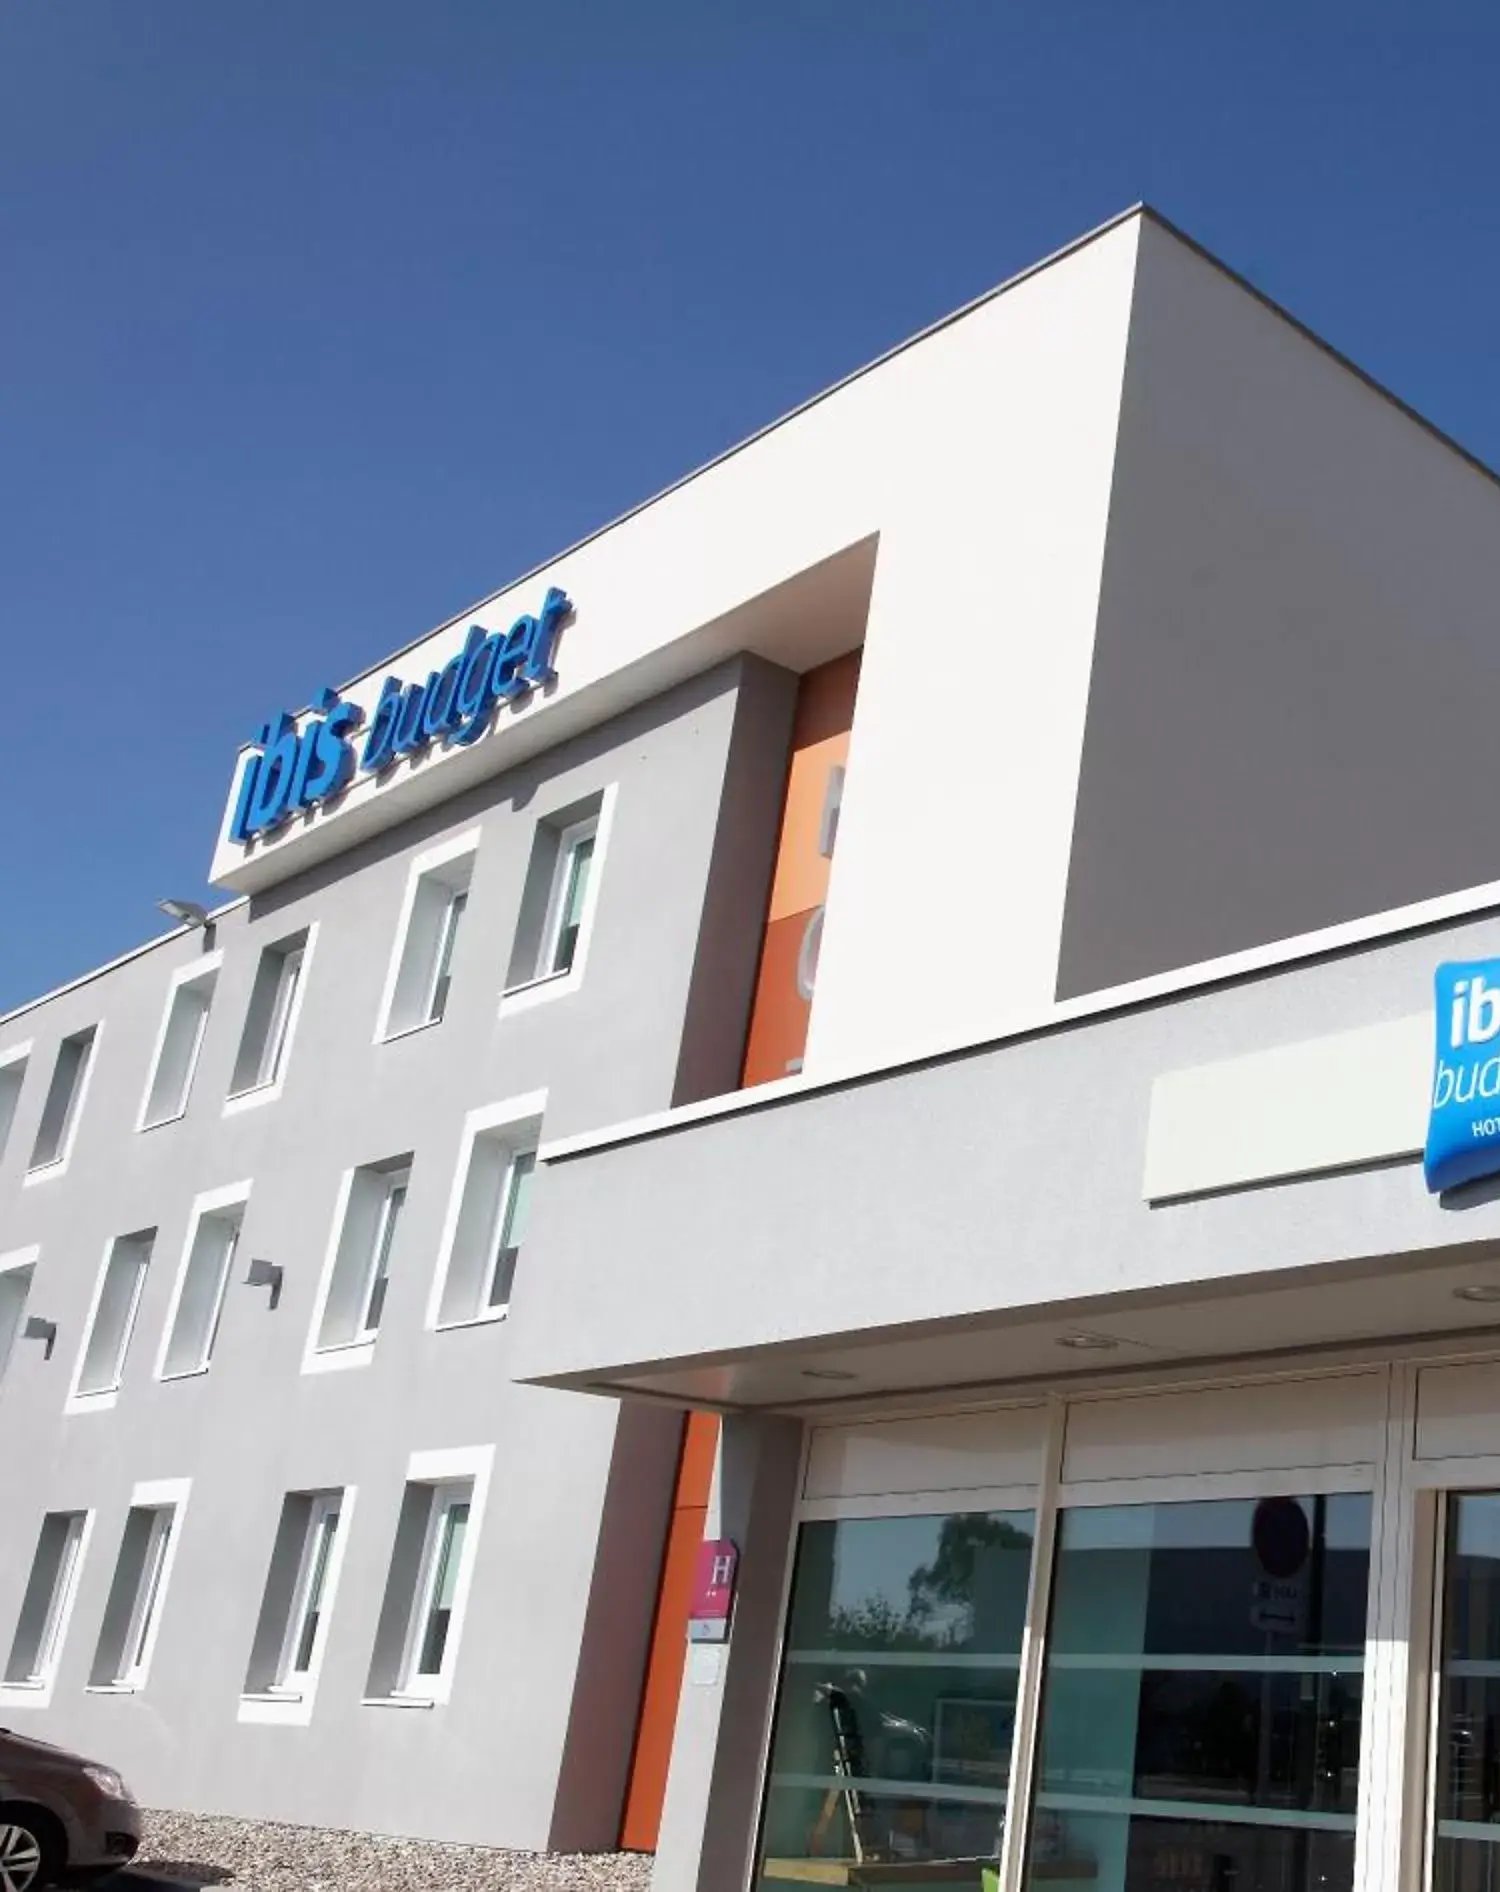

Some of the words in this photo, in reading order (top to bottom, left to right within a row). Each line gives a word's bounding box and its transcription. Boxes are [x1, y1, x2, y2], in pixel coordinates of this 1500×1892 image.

[229, 688, 365, 843] ibis
[360, 587, 573, 772] budget
[711, 1555, 731, 1585] H
